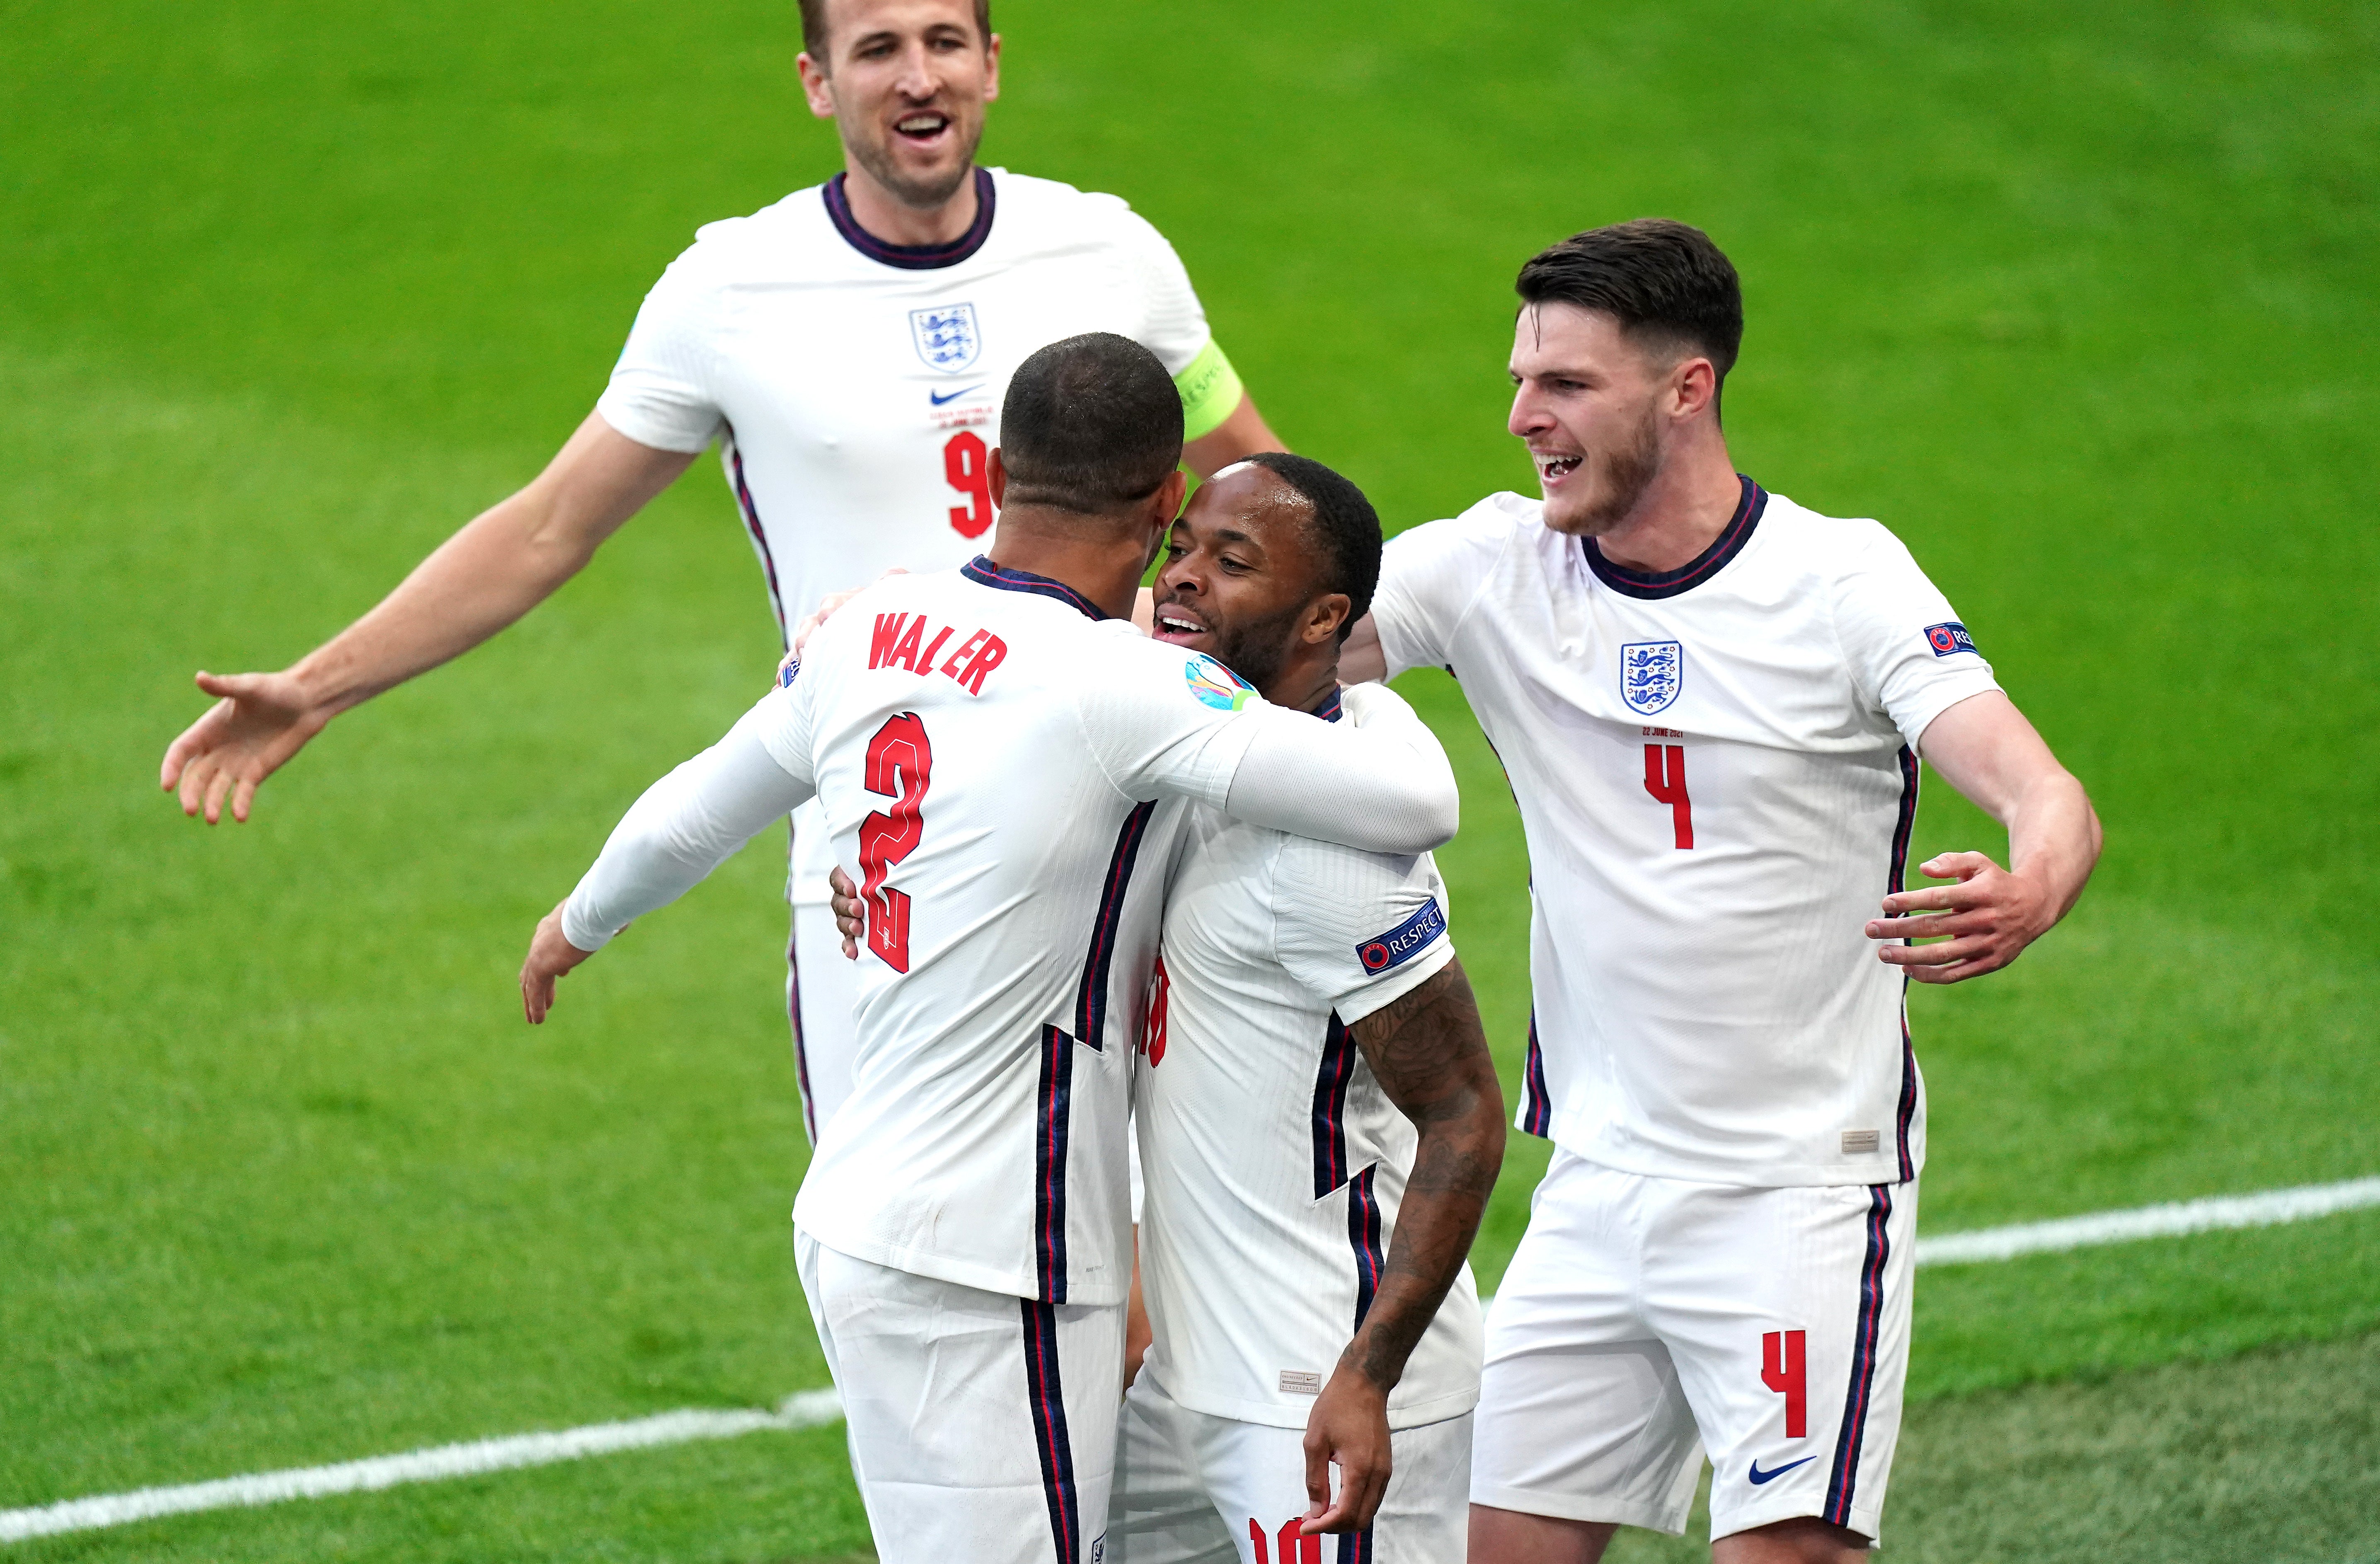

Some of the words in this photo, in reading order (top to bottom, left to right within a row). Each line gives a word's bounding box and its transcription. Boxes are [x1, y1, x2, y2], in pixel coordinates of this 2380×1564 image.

[944, 430, 994, 539] 9
[1642, 727, 1650, 736] 22
[1652, 728, 1668, 737] JUNE
[858, 711, 932, 974] 2
[1644, 744, 1693, 849] 4
[1365, 945, 1380, 953] UEFA
[1389, 906, 1441, 955] RESPECT
[1761, 1330, 1807, 1438] 4
